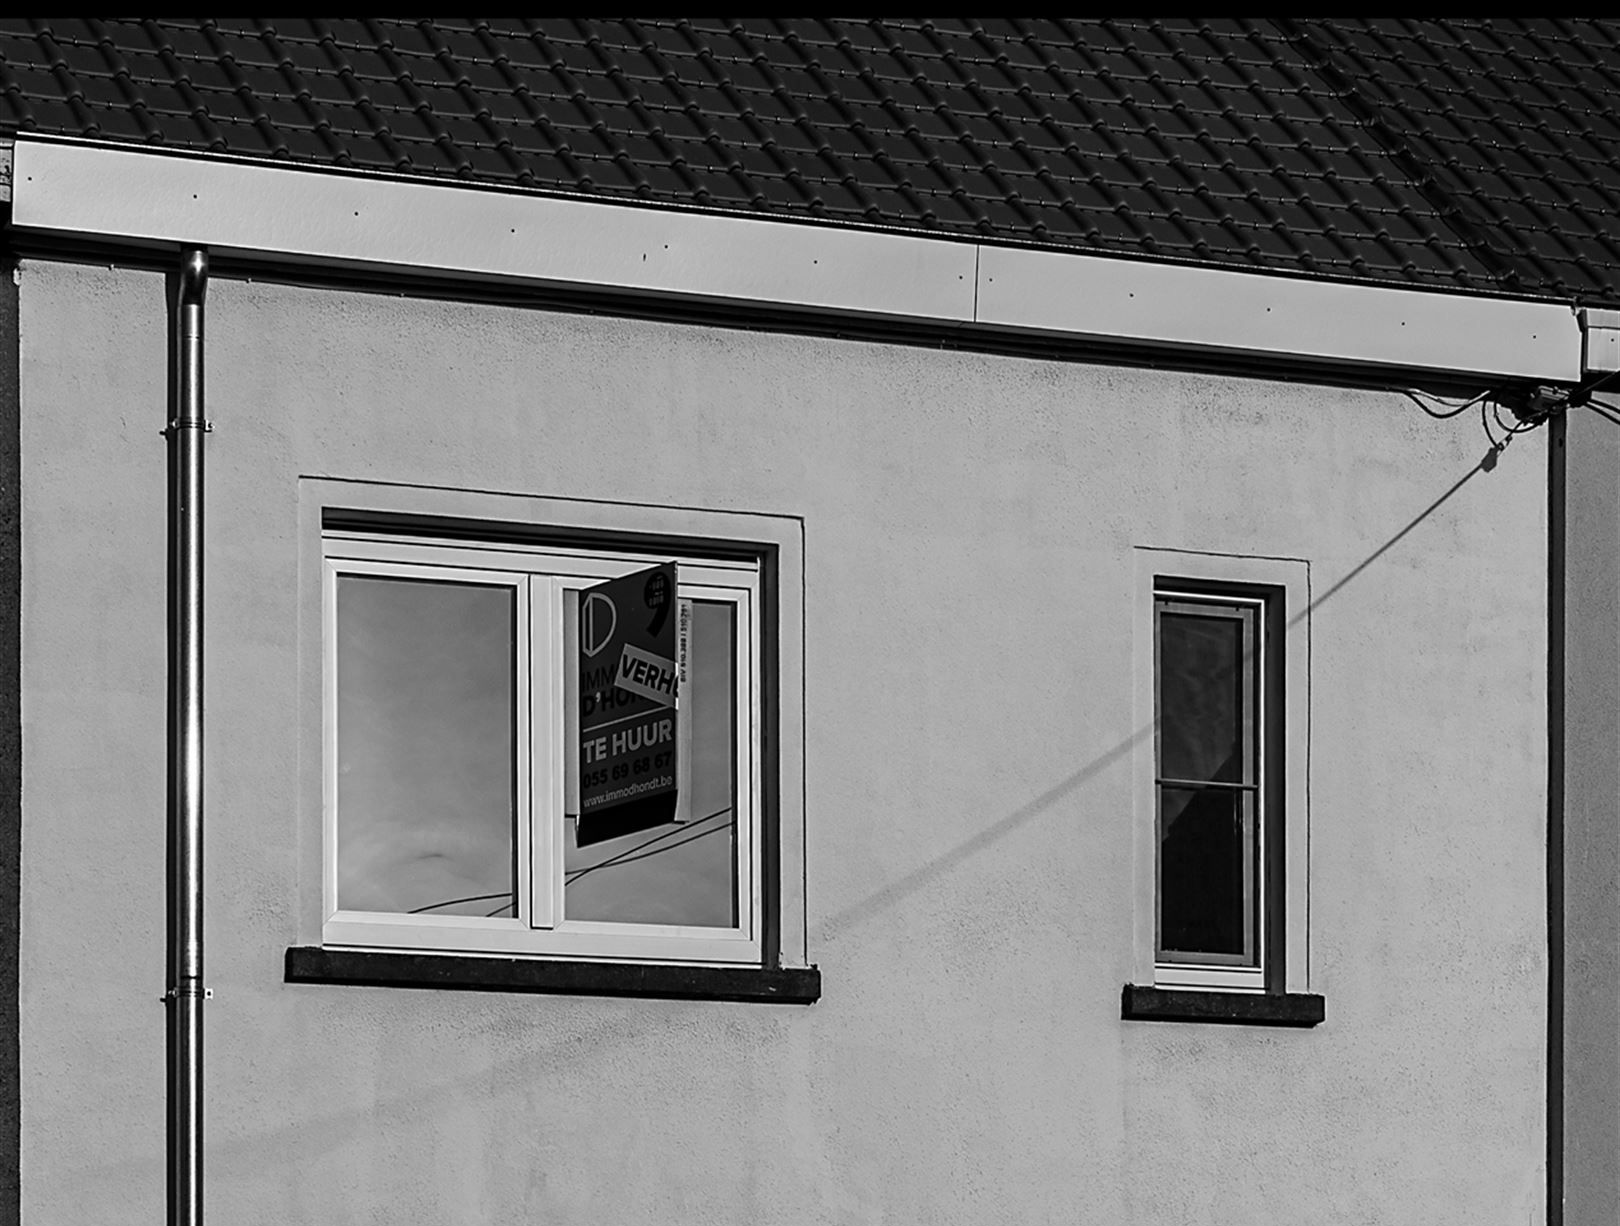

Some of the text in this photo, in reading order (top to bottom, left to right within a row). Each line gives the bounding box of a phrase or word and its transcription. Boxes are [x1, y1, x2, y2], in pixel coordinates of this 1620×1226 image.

[582, 664, 617, 691] IMM
[583, 719, 672, 764] TE HUUR
[583, 751, 672, 788] 055 69 68 67
[583, 775, 673, 808] www.immodhondt.be
